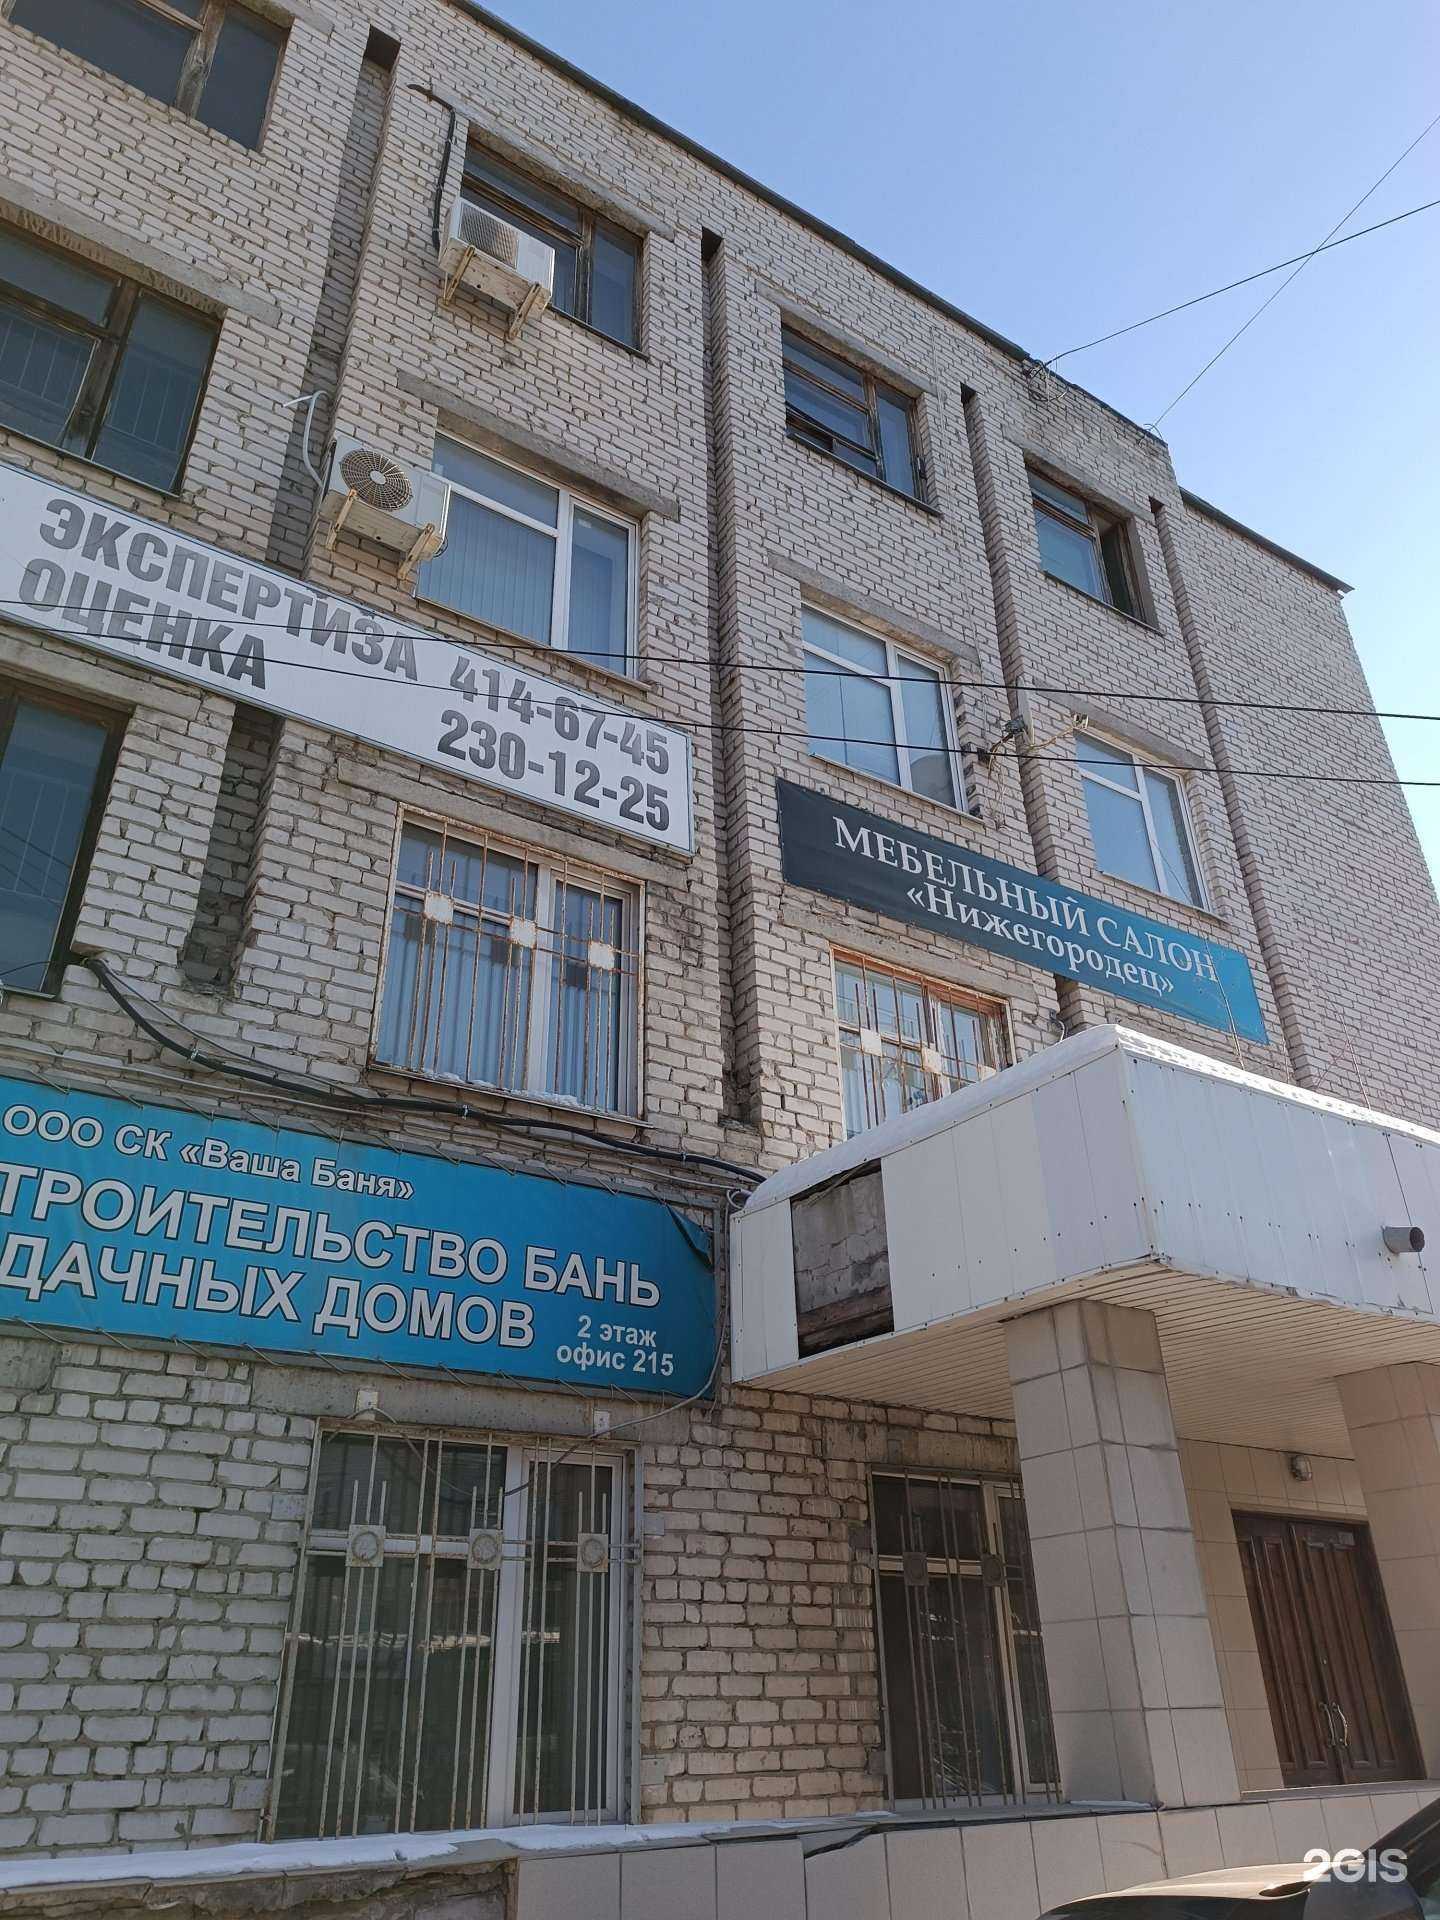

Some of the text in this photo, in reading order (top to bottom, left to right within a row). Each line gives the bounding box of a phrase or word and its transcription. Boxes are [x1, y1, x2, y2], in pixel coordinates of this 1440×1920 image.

[18, 558, 266, 690] ОЦЕНКА
[39, 498, 419, 681] ЭКСПЕРТИЗА
[438, 709, 671, 832] 230-12-25
[450, 655, 671, 775] 414-67-45
[832, 816, 1219, 982] МЕБЕЛЬНЫЙ САЛОН
[906, 883, 1174, 997] «Нижегородец»
[114, 1125, 172, 1161] СК
[179, 1137, 301, 1183] «Ваша
[311, 1158, 415, 1200] Баня»
[0, 1232, 535, 1350] ДАЧНЫХ ДОМОВ
[524, 1246, 661, 1309] БАНЬ
[577, 1315, 658, 1348] 2 этаж
[556, 1343, 675, 1377] офис 215
